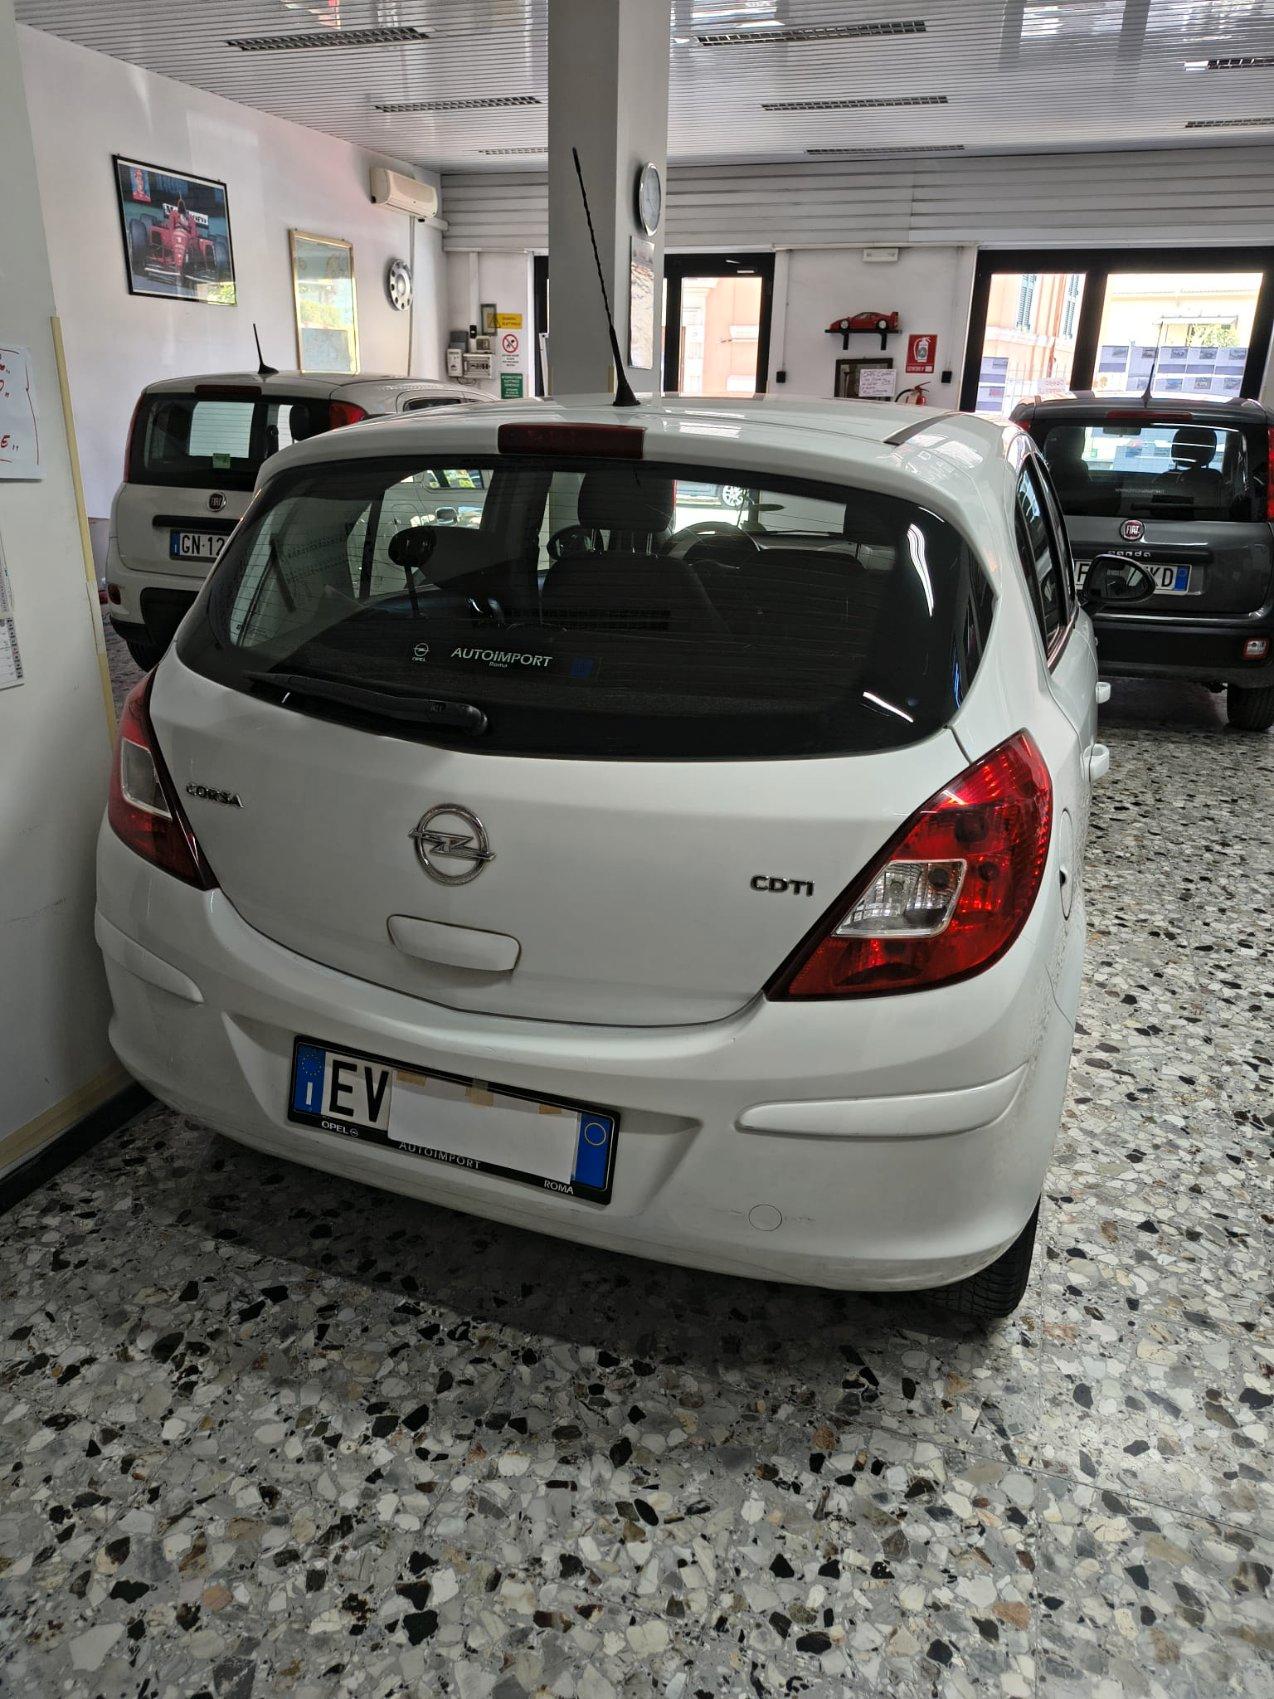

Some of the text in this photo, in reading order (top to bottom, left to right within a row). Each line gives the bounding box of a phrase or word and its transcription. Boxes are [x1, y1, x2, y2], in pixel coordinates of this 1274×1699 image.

[1126, 525, 1140, 535] FIAT
[450, 647, 553, 667] AUTOIMPORT
[186, 782, 245, 808] CORSA
[750, 874, 815, 897] CDTI
[328, 1058, 390, 1123] EV
[321, 1120, 349, 1136] OPEL
[398, 1141, 482, 1170] AUTOIMPORT
[544, 1179, 575, 1196] ROMA
